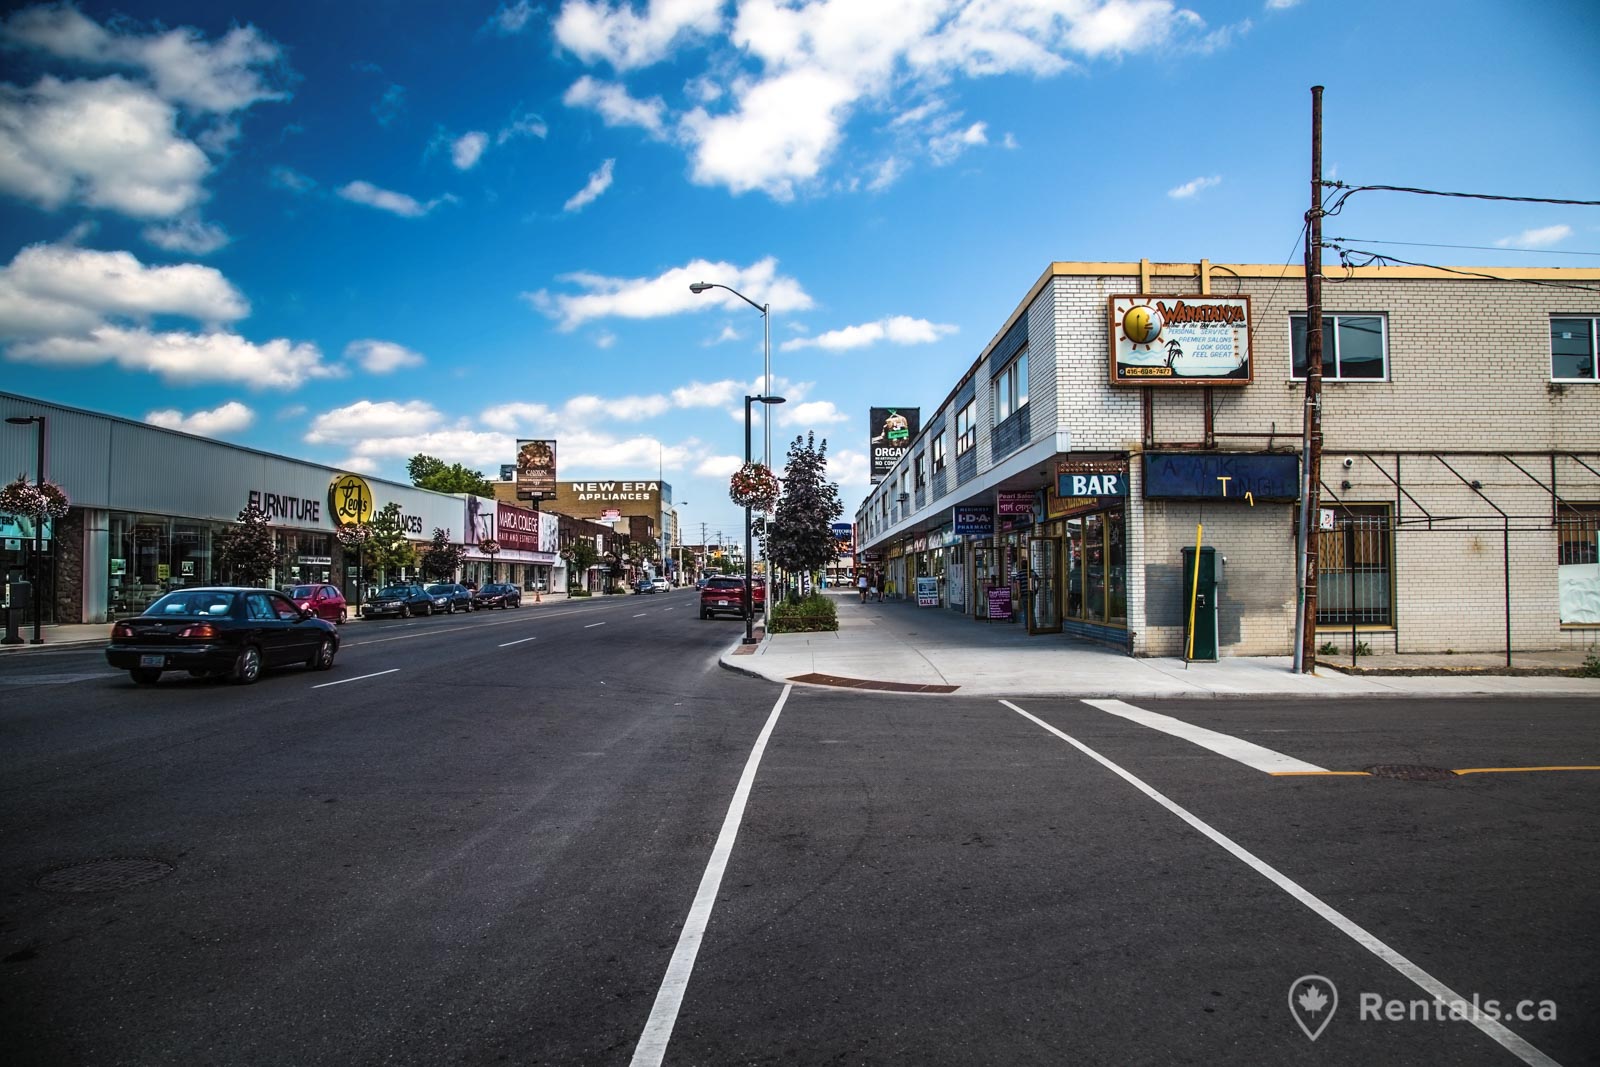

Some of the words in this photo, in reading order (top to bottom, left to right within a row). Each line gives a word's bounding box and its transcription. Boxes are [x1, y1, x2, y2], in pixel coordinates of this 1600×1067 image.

[572, 483, 615, 492] NEW
[622, 483, 659, 491] ERA
[1072, 475, 1118, 495] BAR
[249, 490, 320, 522] FURNITURE
[499, 511, 517, 529] MARCA
[518, 515, 538, 533] COLLEGE
[499, 532, 508, 540] HAIR
[520, 534, 538, 544] ESTHETICS
